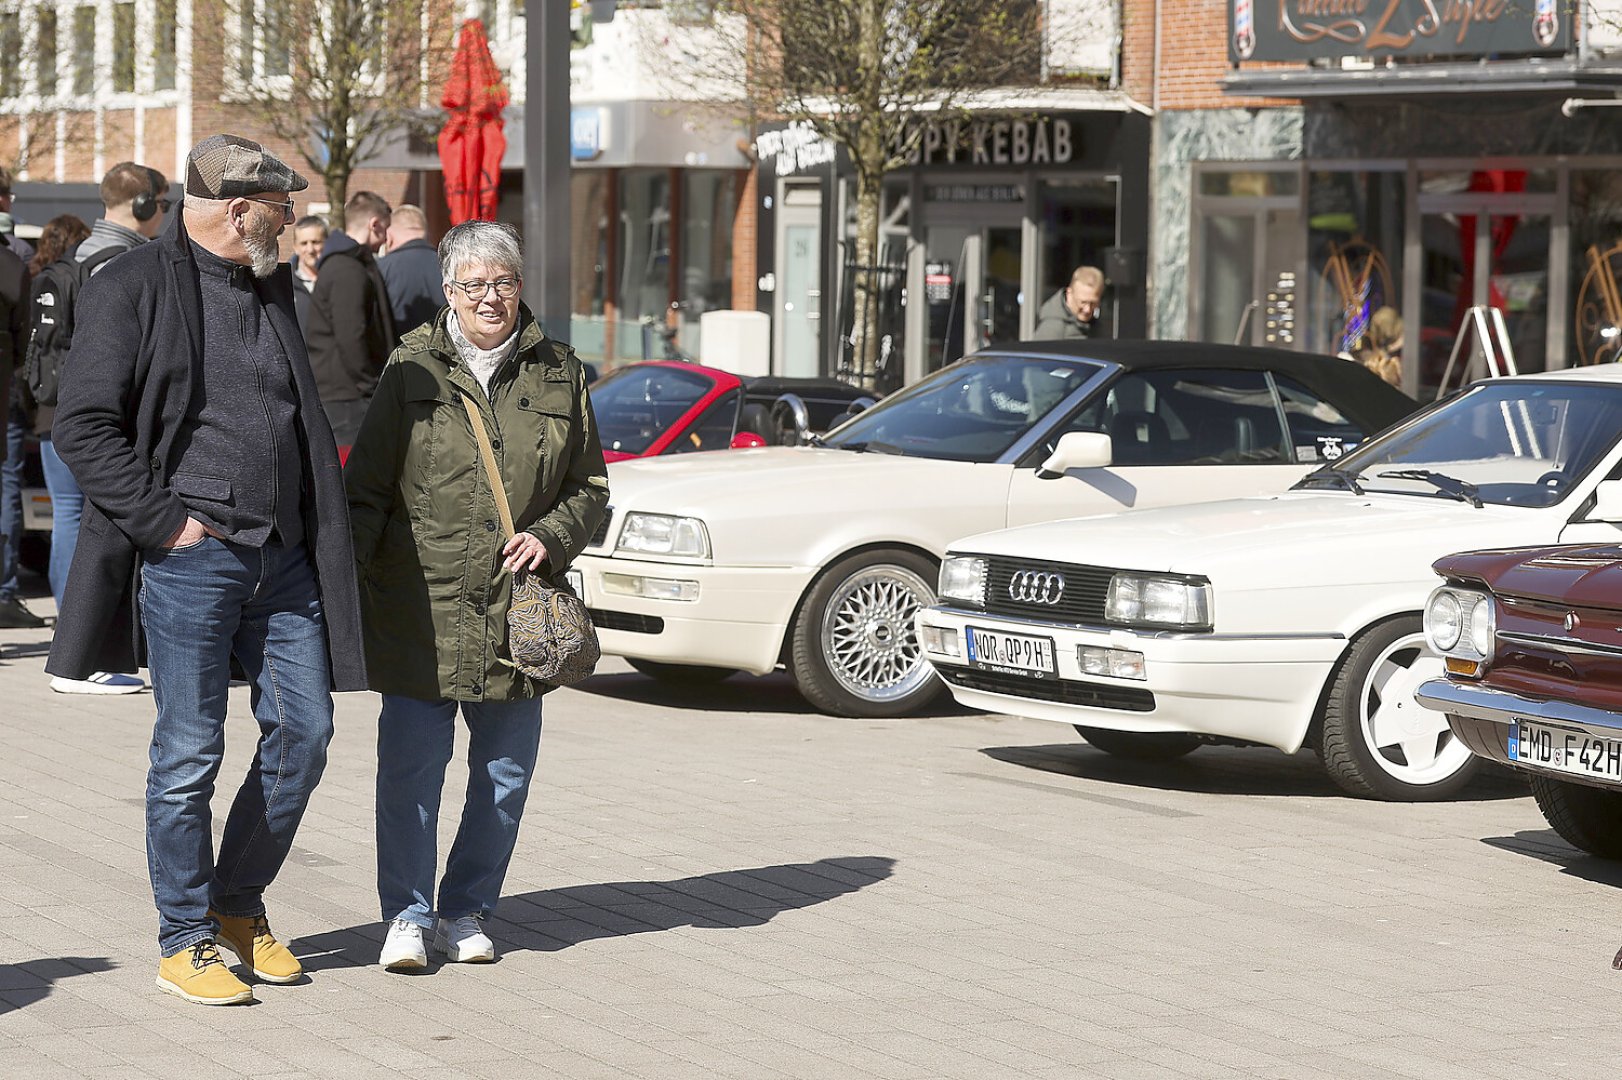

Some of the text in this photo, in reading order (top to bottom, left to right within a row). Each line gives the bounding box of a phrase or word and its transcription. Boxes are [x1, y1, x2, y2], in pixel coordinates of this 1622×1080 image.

[972, 119, 1073, 164] KEBAB
[974, 633, 999, 661] NOR
[1518, 725, 1552, 763] EMD
